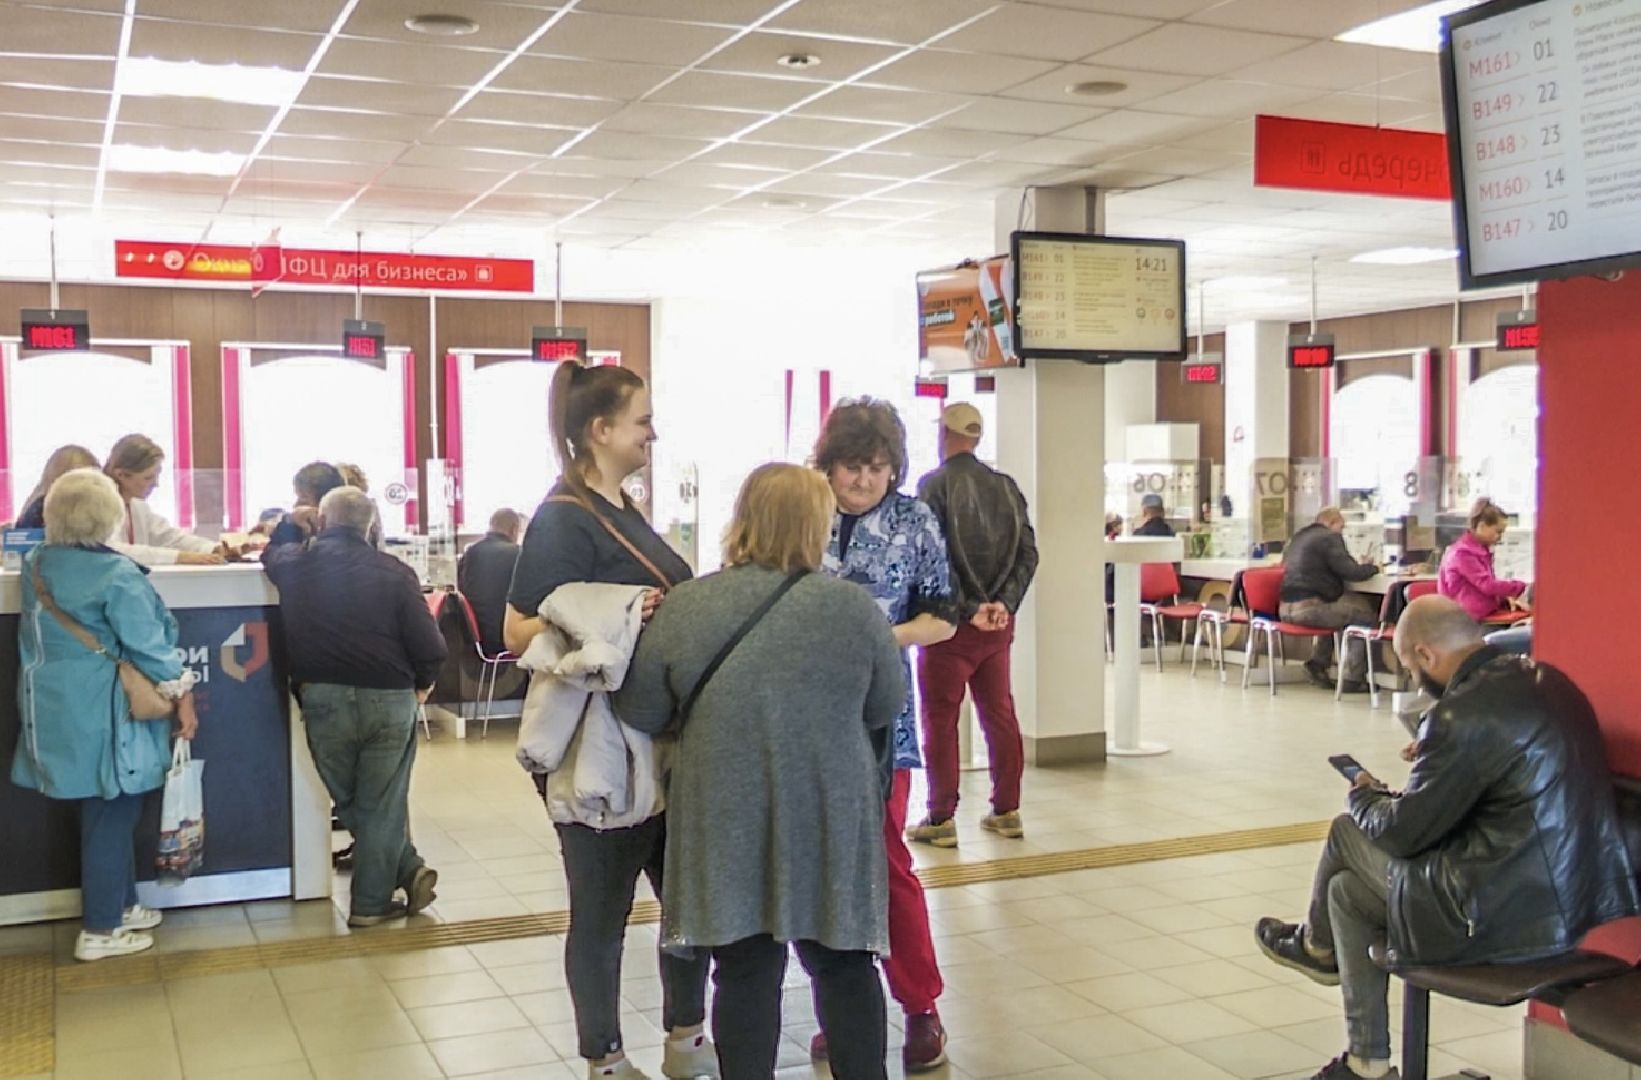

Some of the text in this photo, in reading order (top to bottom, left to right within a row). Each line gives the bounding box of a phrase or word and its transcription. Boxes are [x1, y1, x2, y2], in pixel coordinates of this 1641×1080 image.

[1469, 39, 1554, 79] М161 01
[1472, 94, 1512, 120] В149
[1537, 82, 1558, 103] 22
[1476, 125, 1561, 161] В148 23
[1479, 176, 1523, 201] М160
[1545, 168, 1565, 189] 14
[1482, 210, 1568, 242] В147 20
[333, 262, 369, 280] для
[377, 260, 468, 282] бизнеса»
[1135, 257, 1167, 272] 14:21
[177, 645, 209, 664] ои
